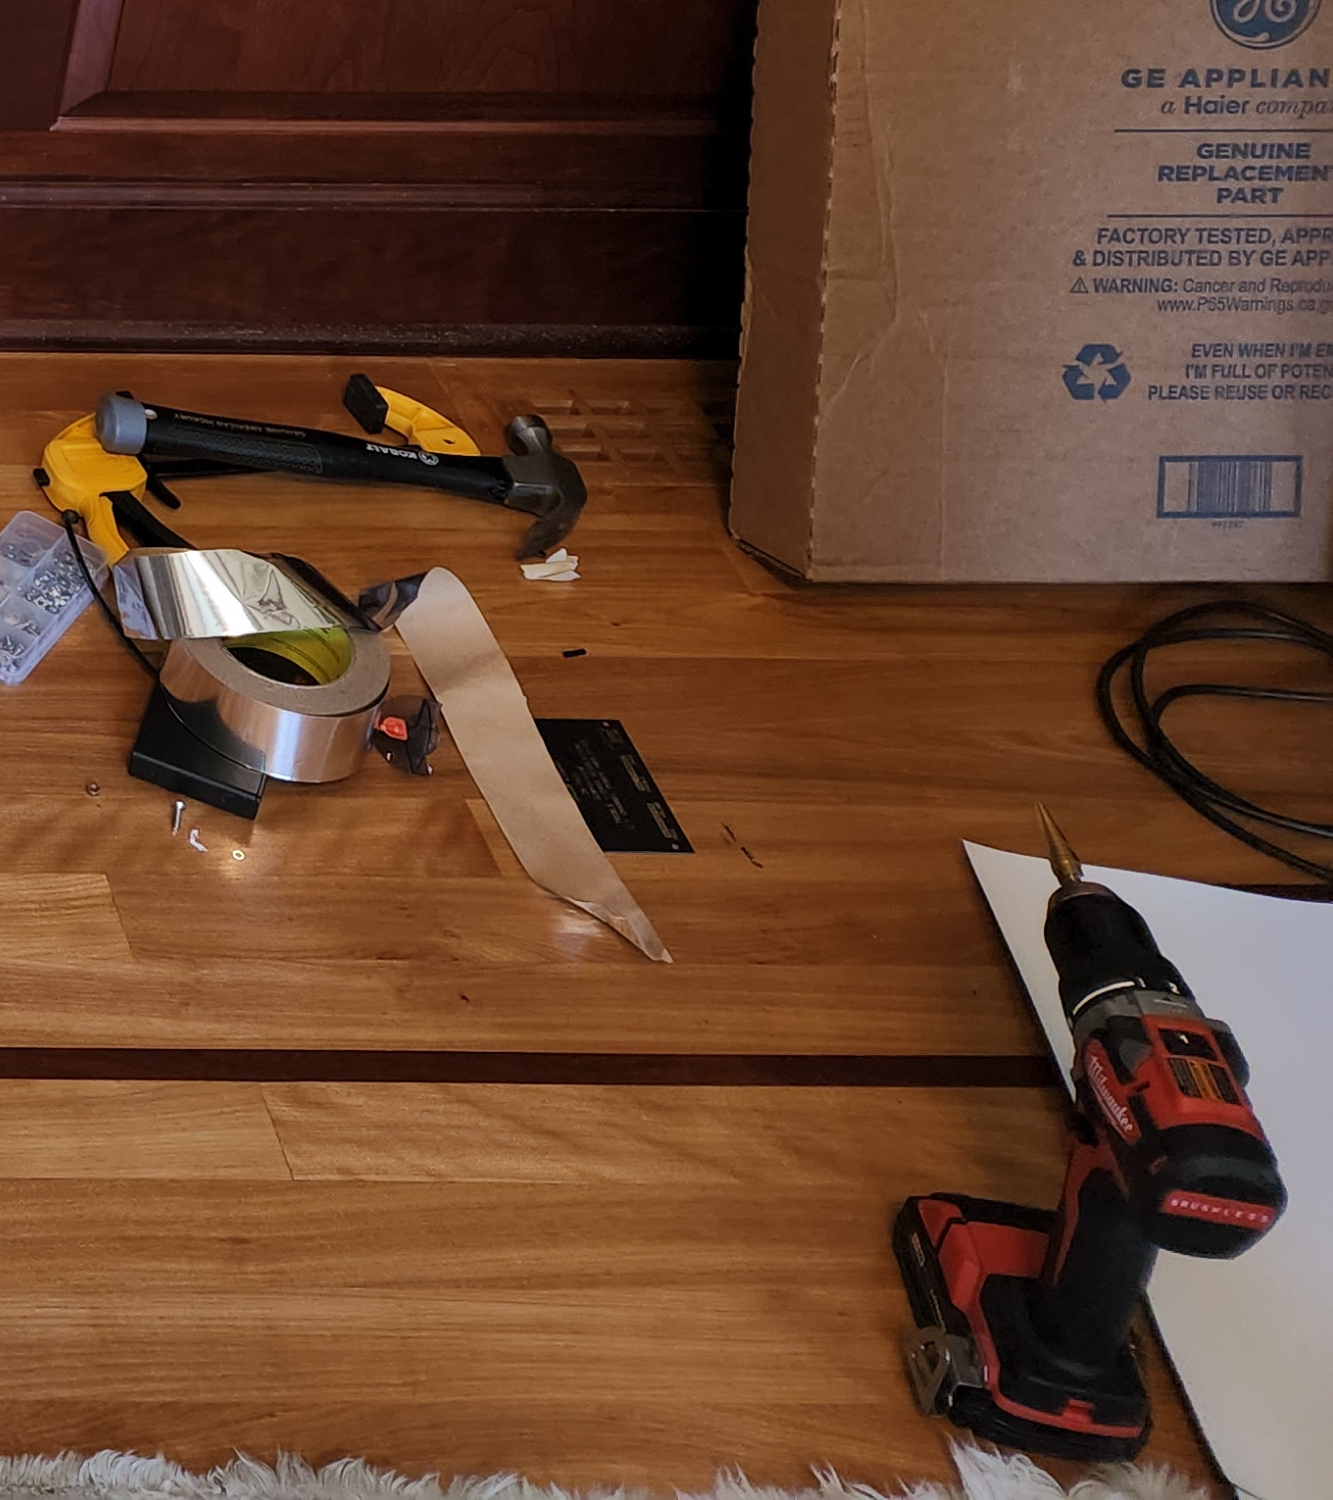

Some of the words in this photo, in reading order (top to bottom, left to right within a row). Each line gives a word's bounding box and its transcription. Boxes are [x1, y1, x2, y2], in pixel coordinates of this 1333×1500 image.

[1121, 68, 1166, 89] GE
[1161, 100, 1176, 114] a
[1184, 94, 1250, 115] Haier
[1255, 100, 1333, 119] compa
[1196, 143, 1312, 160] GENUINE
[1217, 187, 1284, 204] PART
[1097, 228, 1191, 244] FACTORY
[1195, 228, 1276, 247] TESTED,
[1073, 250, 1086, 267] &
[1092, 250, 1222, 267] DISTRIBUTED
[1228, 250, 1253, 267] BY
[1260, 250, 1287, 267] GE
[1291, 250, 1333, 267] APP
[1093, 278, 1179, 293] WARNING:
[1183, 278, 1233, 293] Cancer
[1238, 278, 1265, 293] and
[1269, 278, 1333, 295] Reprodu
[1191, 343, 1233, 358] EVEN
[1238, 343, 1285, 358] WHEN
[1289, 343, 1312, 358] I'M
[1185, 364, 1207, 379] I'M
[1211, 364, 1251, 379] FULL
[1255, 364, 1277, 379] OF
[1148, 385, 1211, 401] PLEASE
[1215, 385, 1268, 400] REUSE
[1272, 385, 1295, 400] OR
[215, 420, 262, 432] AMERICAN
[365, 443, 417, 459] KOBALT
[1089, 1054, 1135, 1134] Milwaukee
[1170, 1197, 1270, 1225] BRUSHLESS
